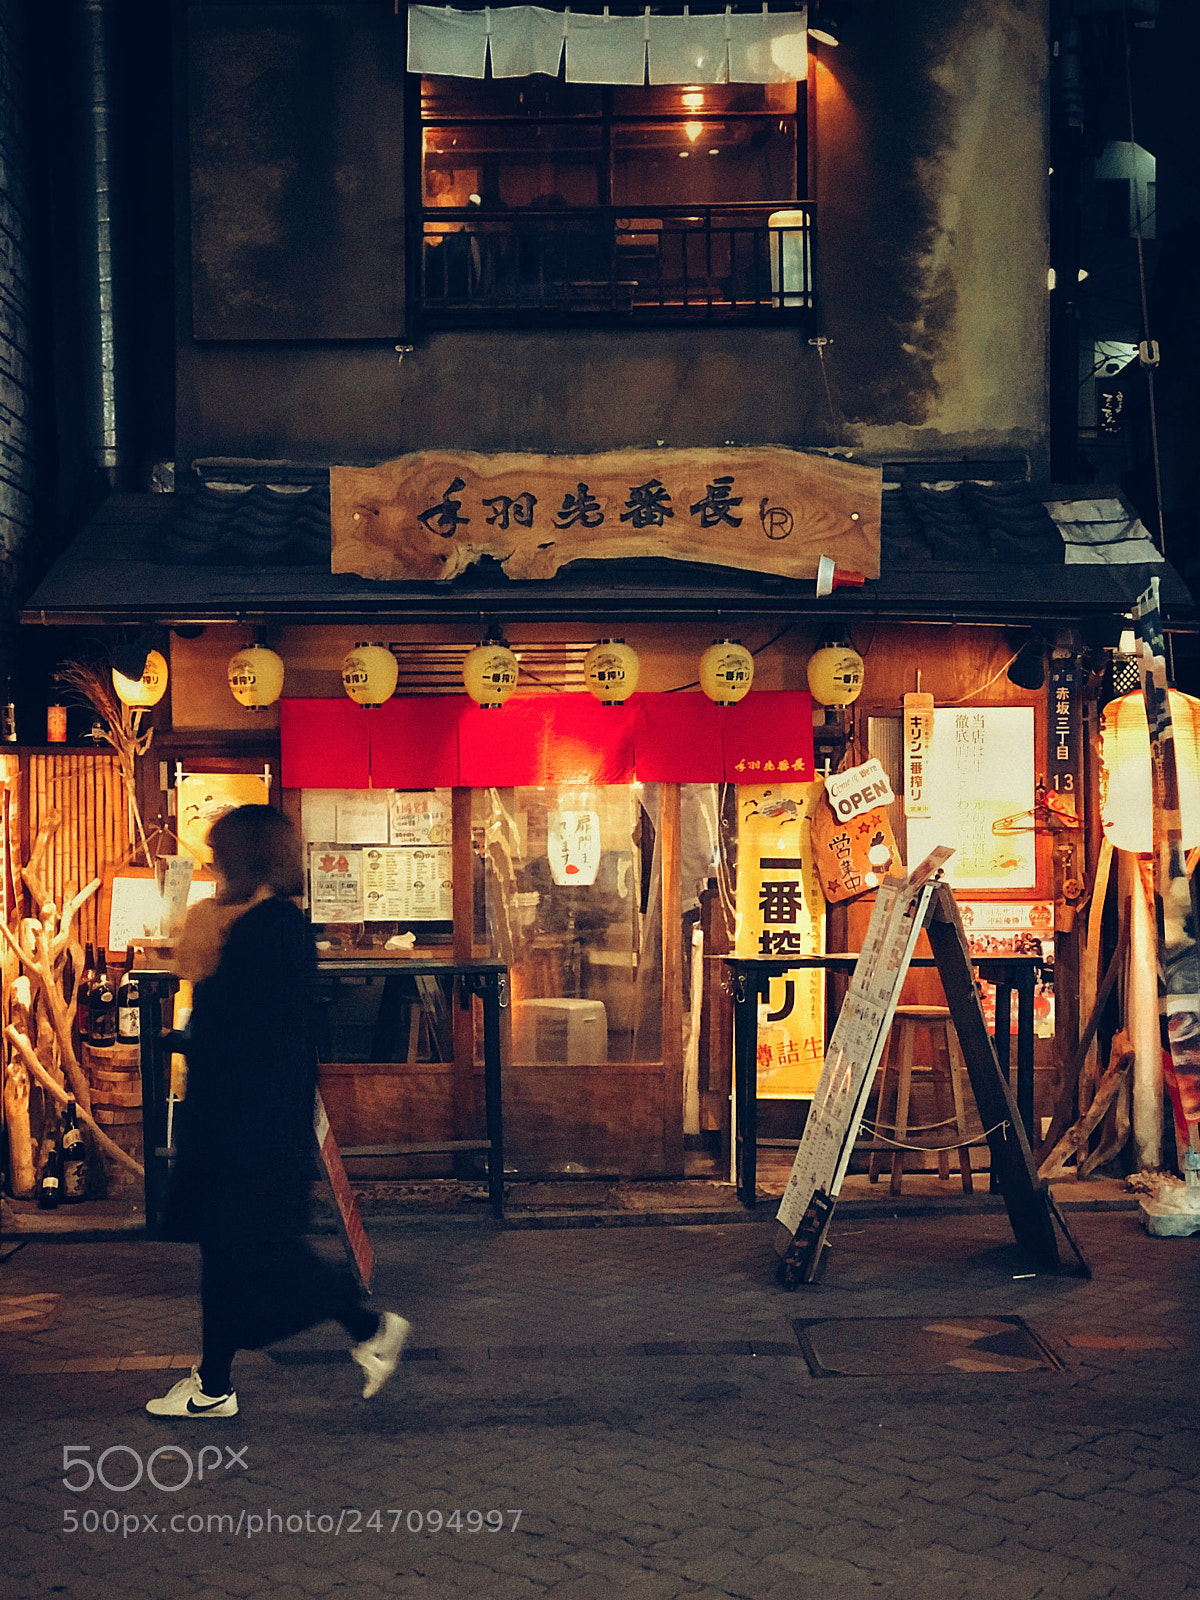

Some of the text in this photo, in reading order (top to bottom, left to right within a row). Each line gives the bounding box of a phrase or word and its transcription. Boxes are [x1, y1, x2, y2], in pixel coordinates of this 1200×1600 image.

[417, 476, 744, 538] 手羽先番長
[1056, 687, 1070, 760] 赤坂三丁目
[909, 716, 923, 802] キリン一番搾り
[1053, 773, 1074, 791] 13
[838, 779, 889, 815] OPEN
[828, 833, 863, 893] 営業中
